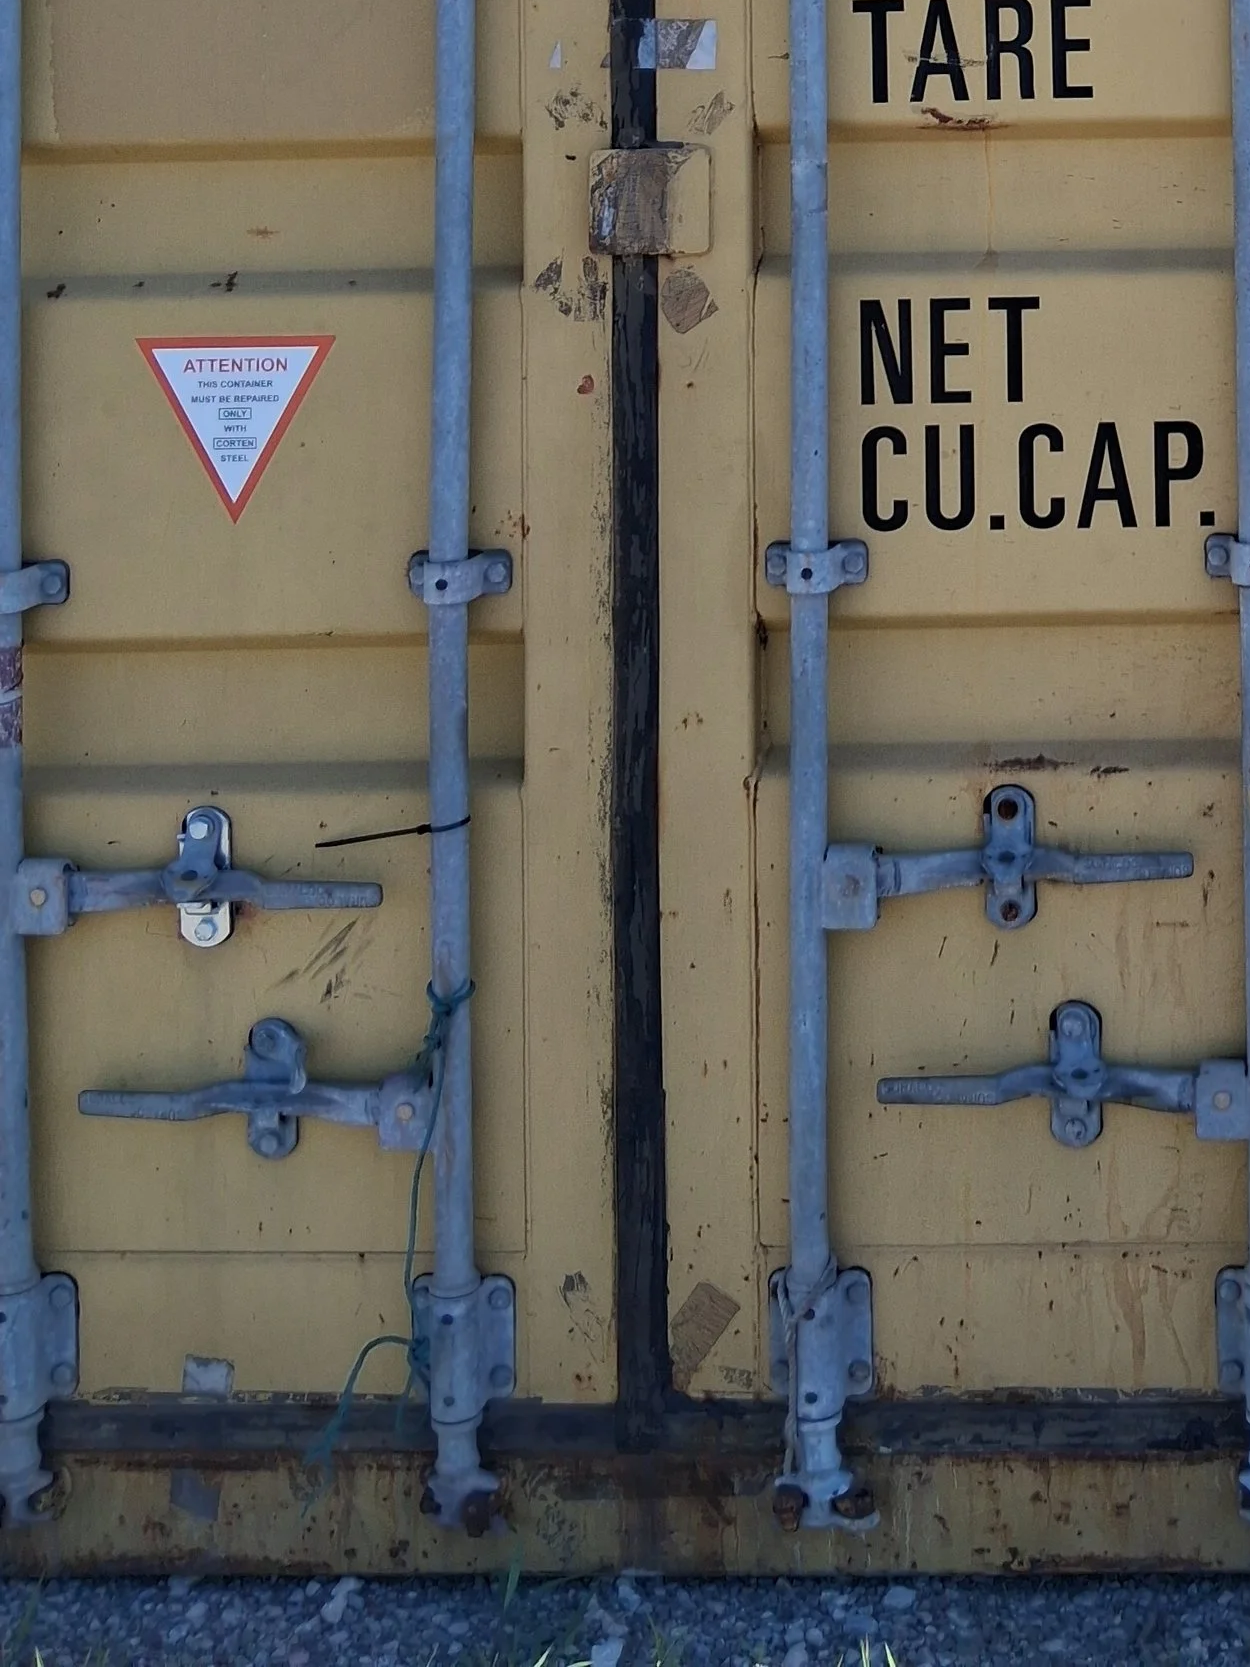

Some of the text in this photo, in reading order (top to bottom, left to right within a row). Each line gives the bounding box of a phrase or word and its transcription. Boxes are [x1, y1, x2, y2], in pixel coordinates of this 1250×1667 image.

[859, 296, 1041, 406] NET
[183, 358, 288, 373] ATTENTION
[198, 380, 273, 388] THIS CONTAINER
[191, 395, 280, 403] MUST BE REPAIRED
[222, 409, 248, 418] ONLY
[215, 439, 254, 448] CORTEN
[220, 454, 249, 462] STEEL
[861, 420, 1217, 532] CU.CAP.
